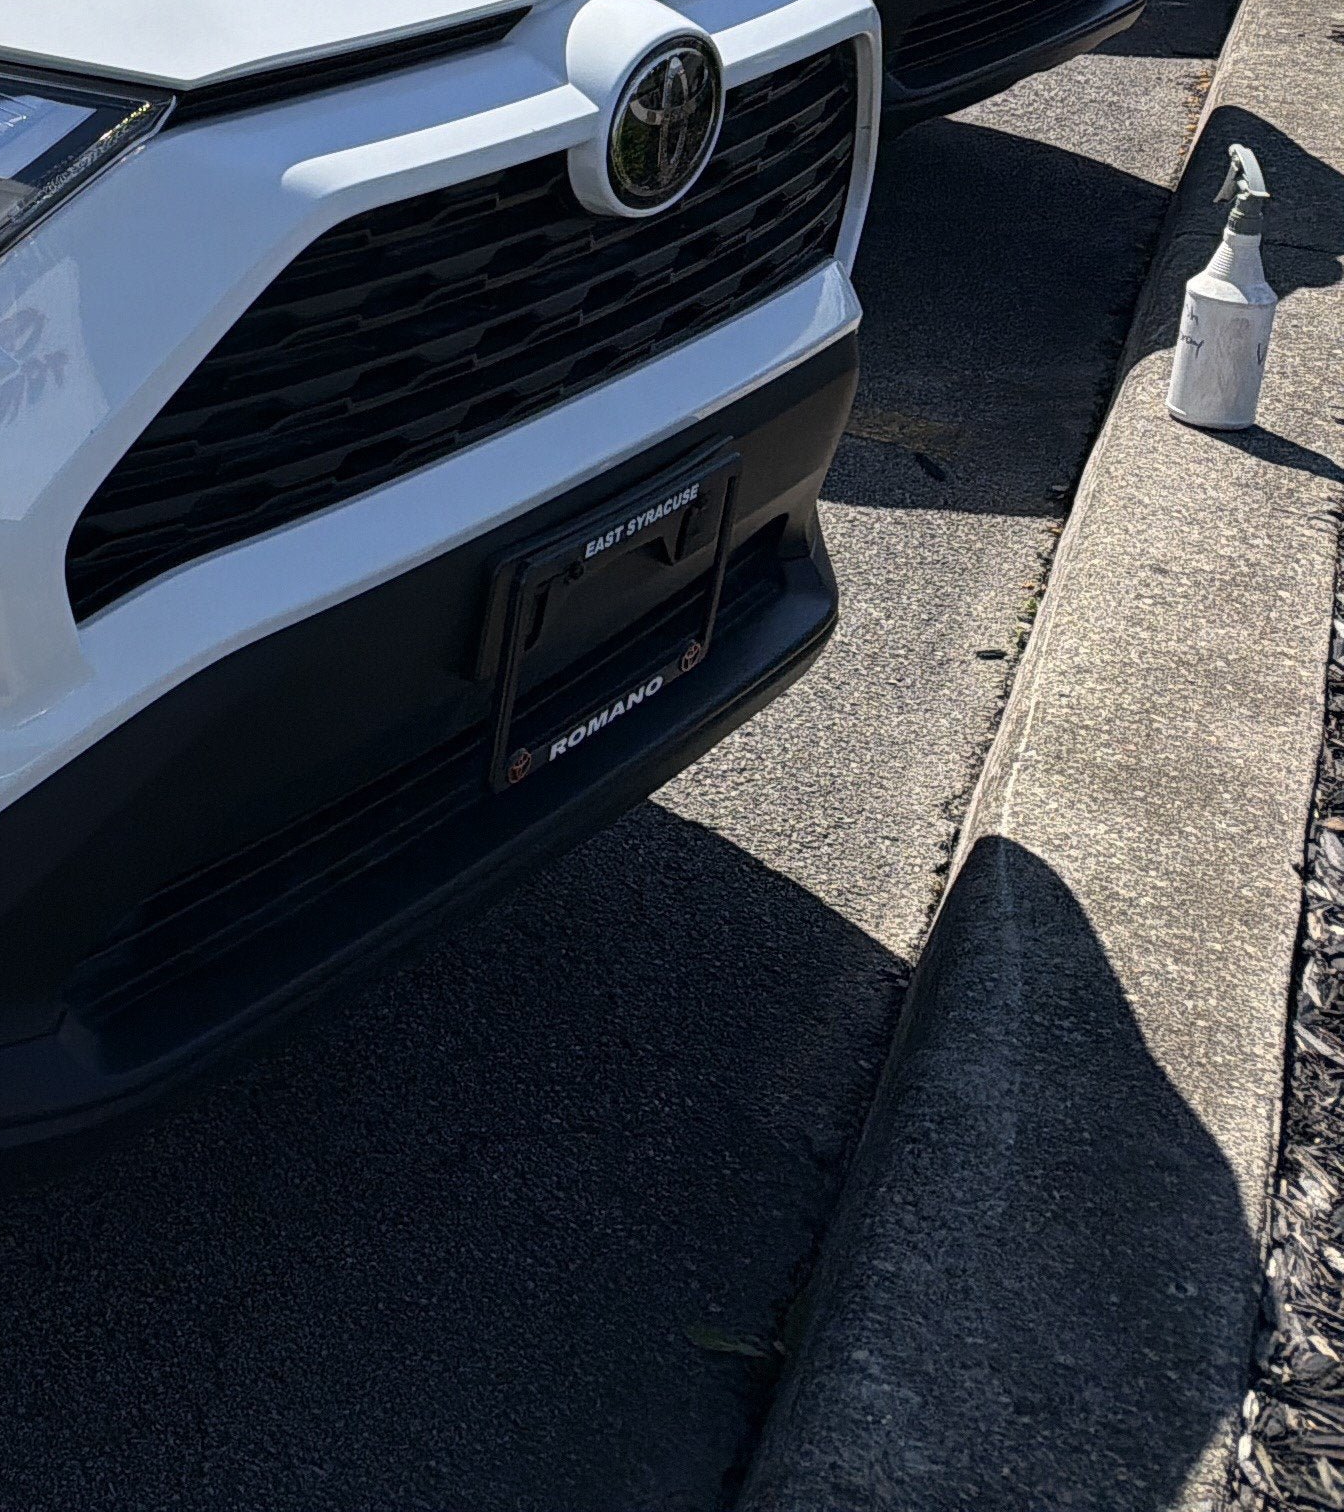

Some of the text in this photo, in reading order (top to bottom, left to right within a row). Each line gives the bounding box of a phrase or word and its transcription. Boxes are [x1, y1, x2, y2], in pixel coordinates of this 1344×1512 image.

[584, 483, 700, 559] EAST SYRACUSE
[548, 675, 664, 762] ROMANO
